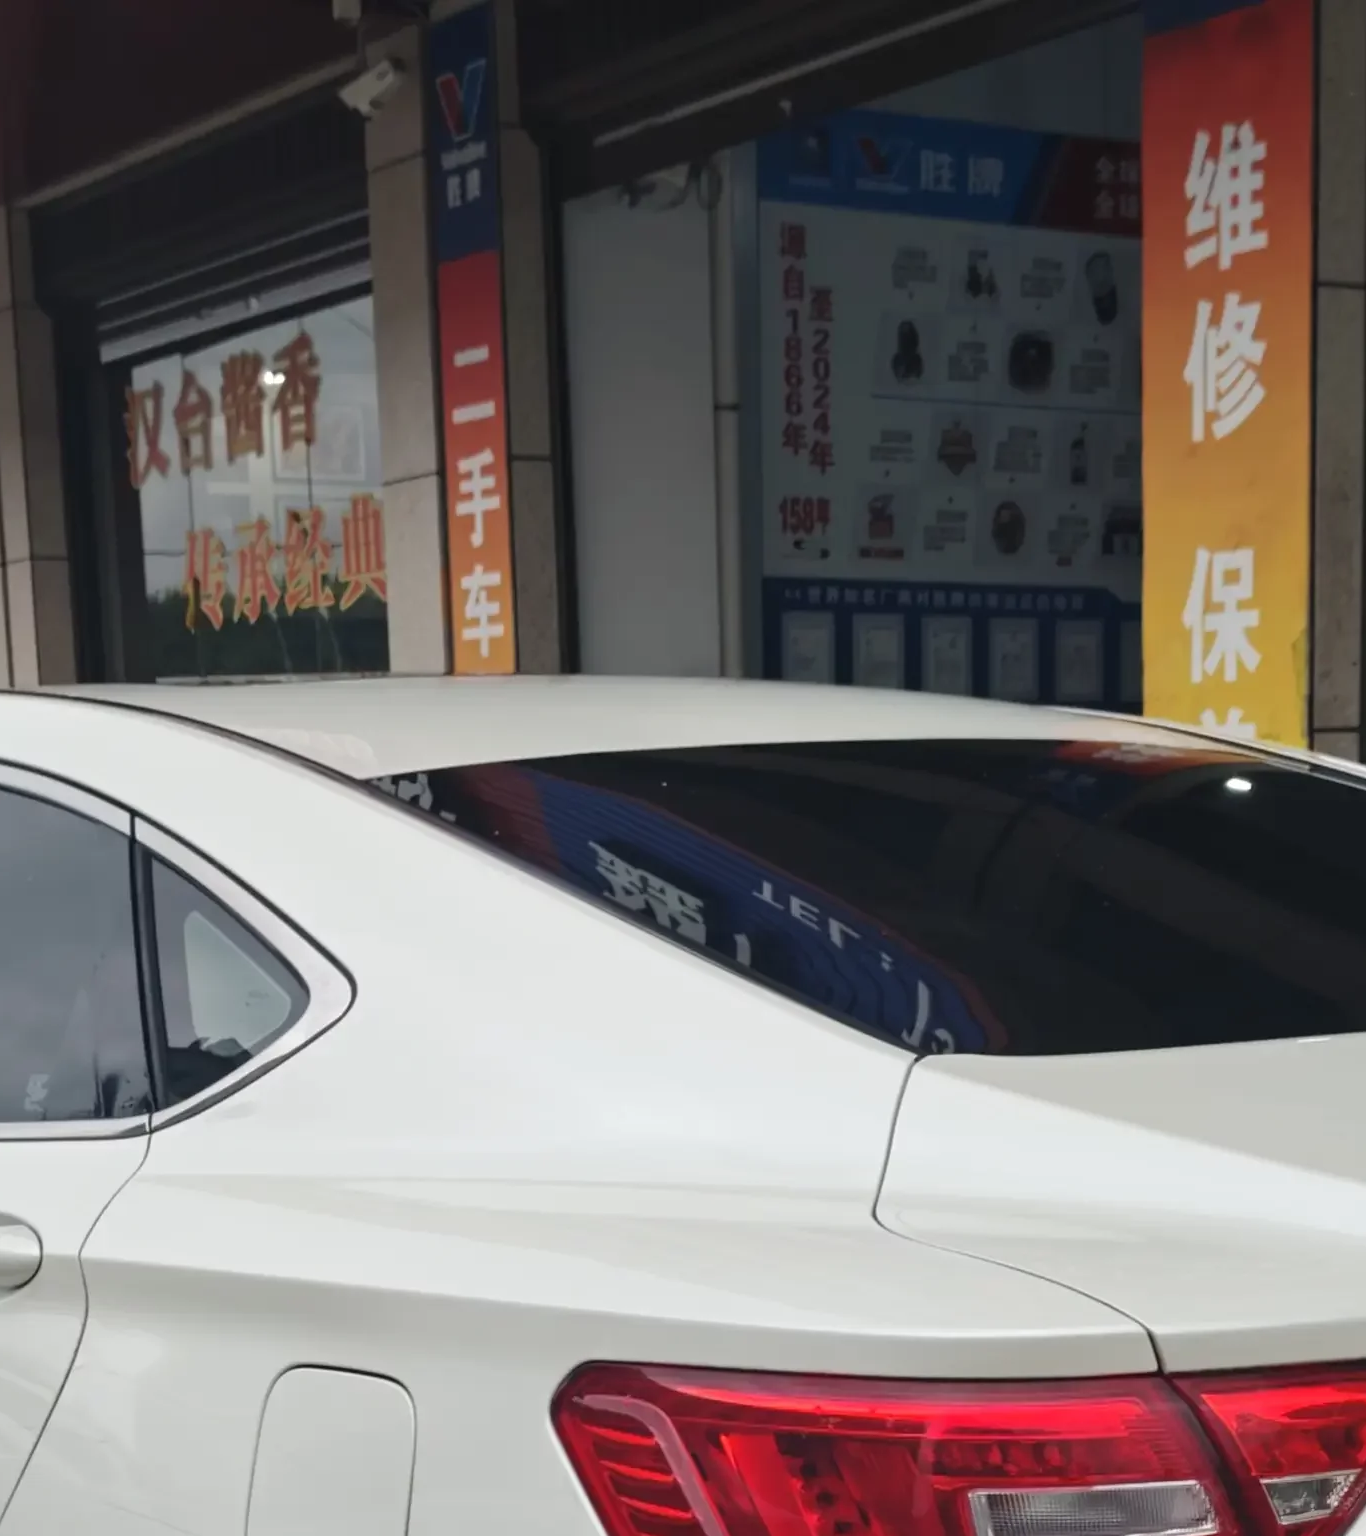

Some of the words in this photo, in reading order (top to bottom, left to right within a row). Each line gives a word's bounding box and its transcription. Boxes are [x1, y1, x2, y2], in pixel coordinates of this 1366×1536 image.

[919, 148, 1004, 198] 胜牌
[1183, 119, 1269, 443] 维修
[780, 222, 807, 457] 源自1866年
[182, 492, 388, 634] 传承经典
[452, 345, 505, 658] 二手车
